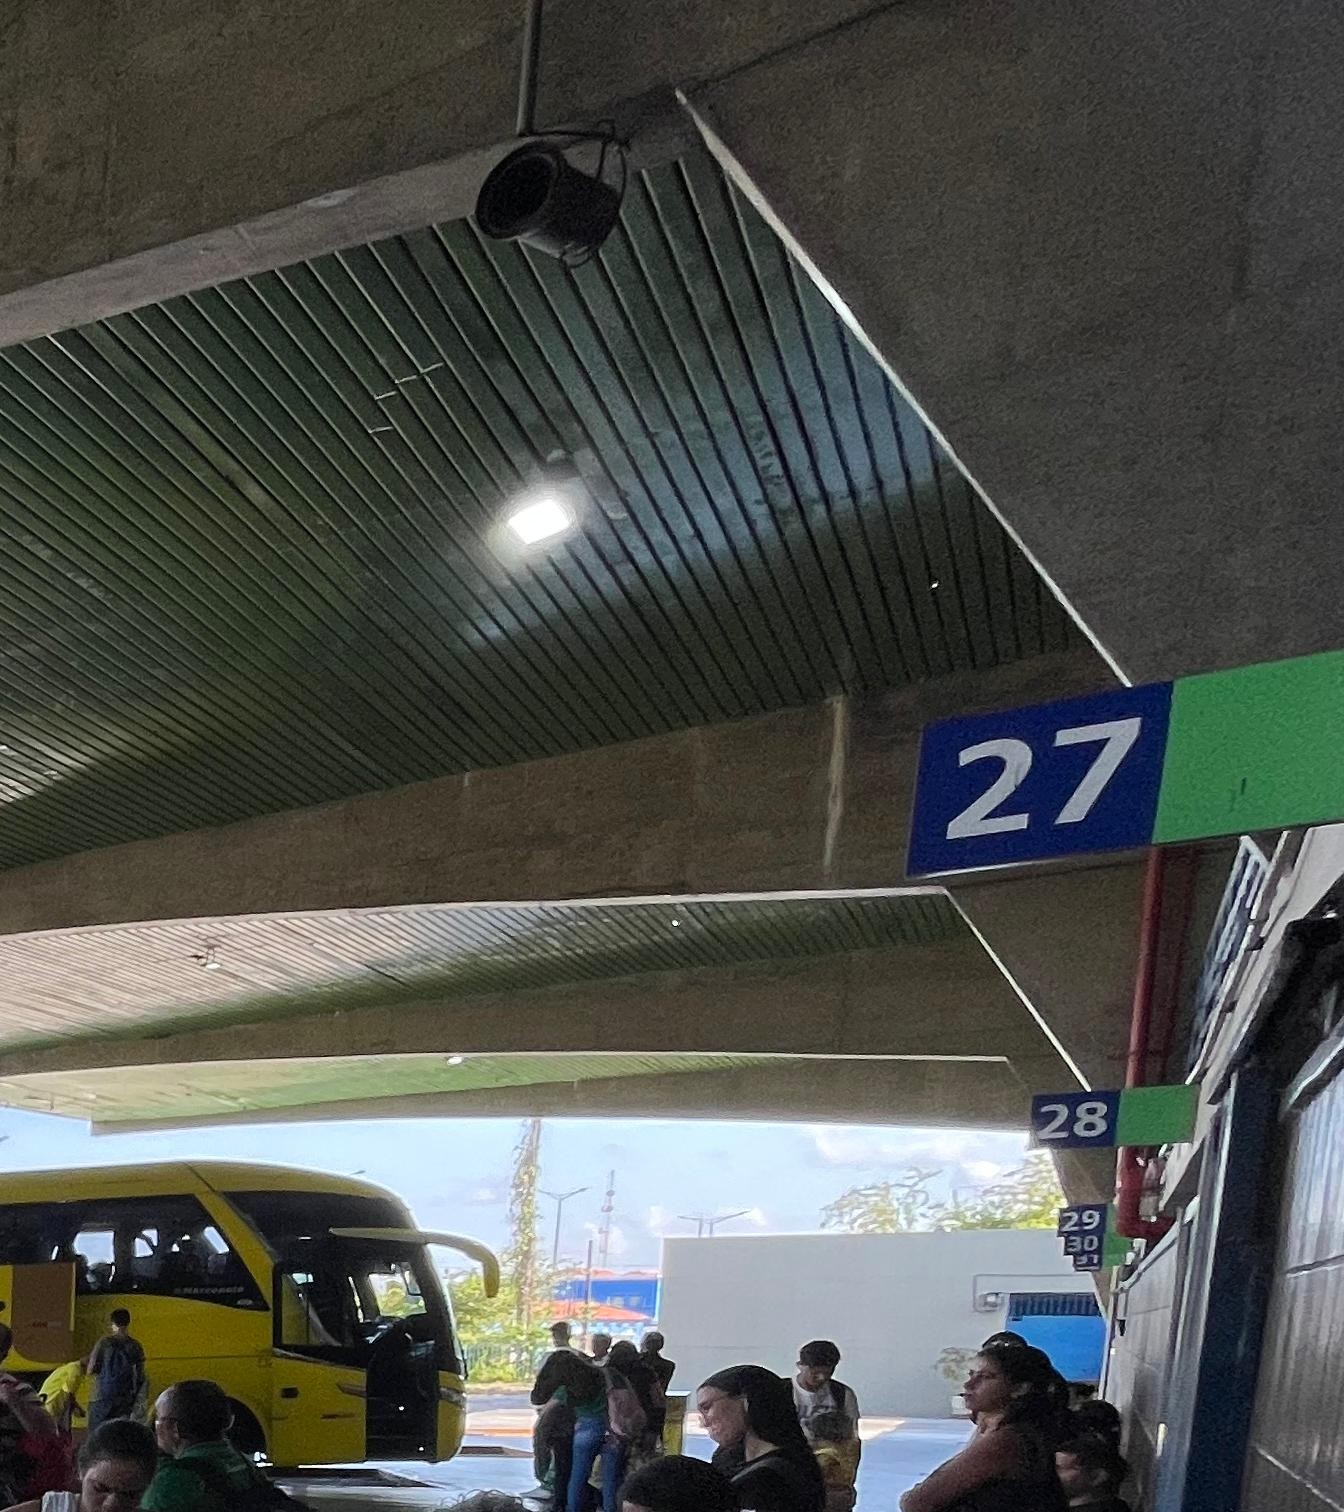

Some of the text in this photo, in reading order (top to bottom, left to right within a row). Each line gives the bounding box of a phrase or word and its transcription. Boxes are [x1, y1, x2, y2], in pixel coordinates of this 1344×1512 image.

[946, 716, 1142, 840] 27
[1038, 1101, 1108, 1139] 28
[1060, 1210, 1100, 1231] 29
[1067, 1235, 1099, 1252] 30
